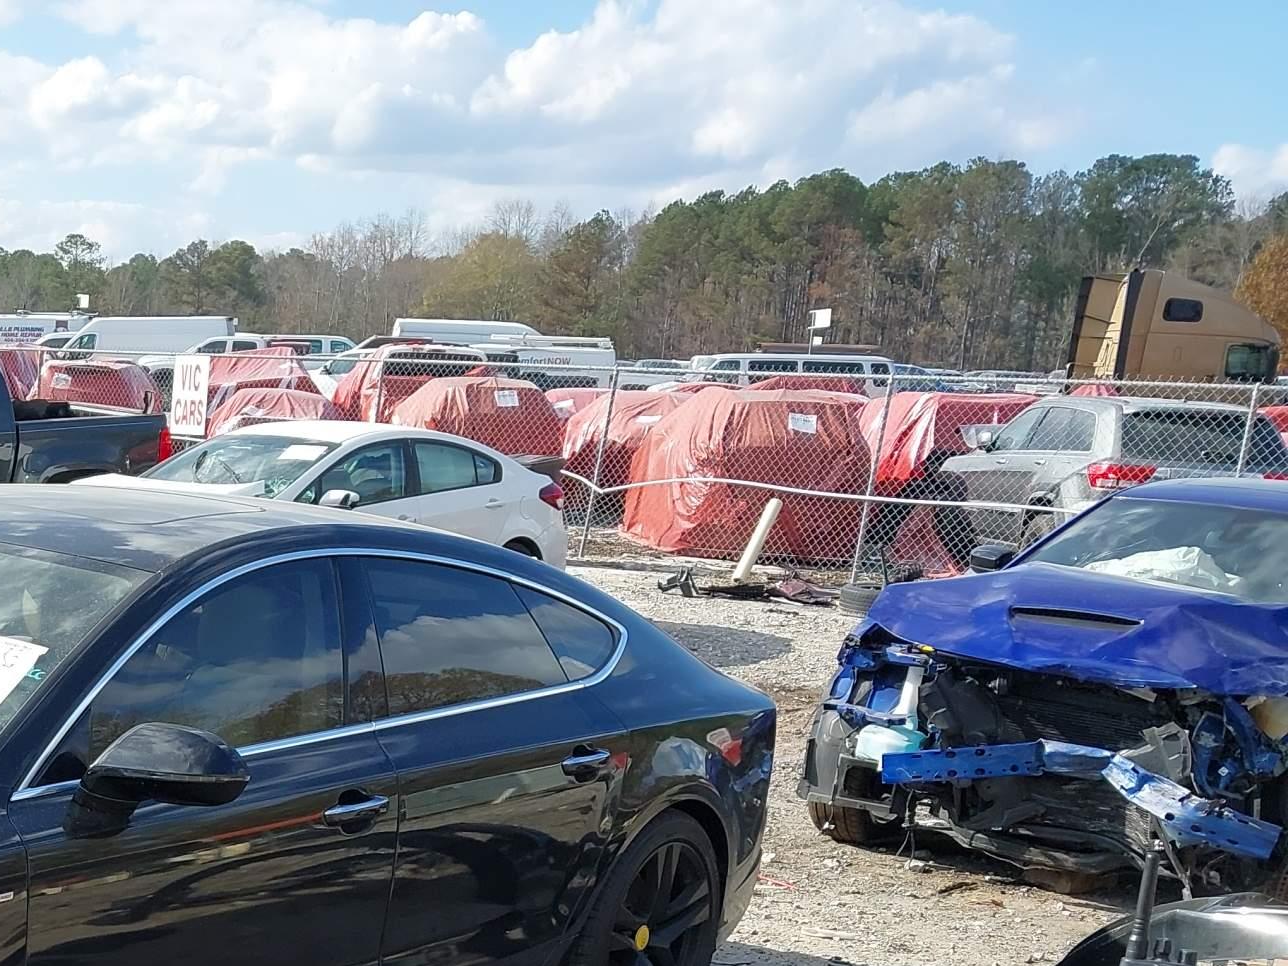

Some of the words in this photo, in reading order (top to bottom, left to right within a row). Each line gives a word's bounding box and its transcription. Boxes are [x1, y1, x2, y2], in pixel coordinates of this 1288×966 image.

[520, 356, 571, 366] mfortNOW
[181, 364, 202, 391] VIC
[174, 398, 204, 426] CARS
